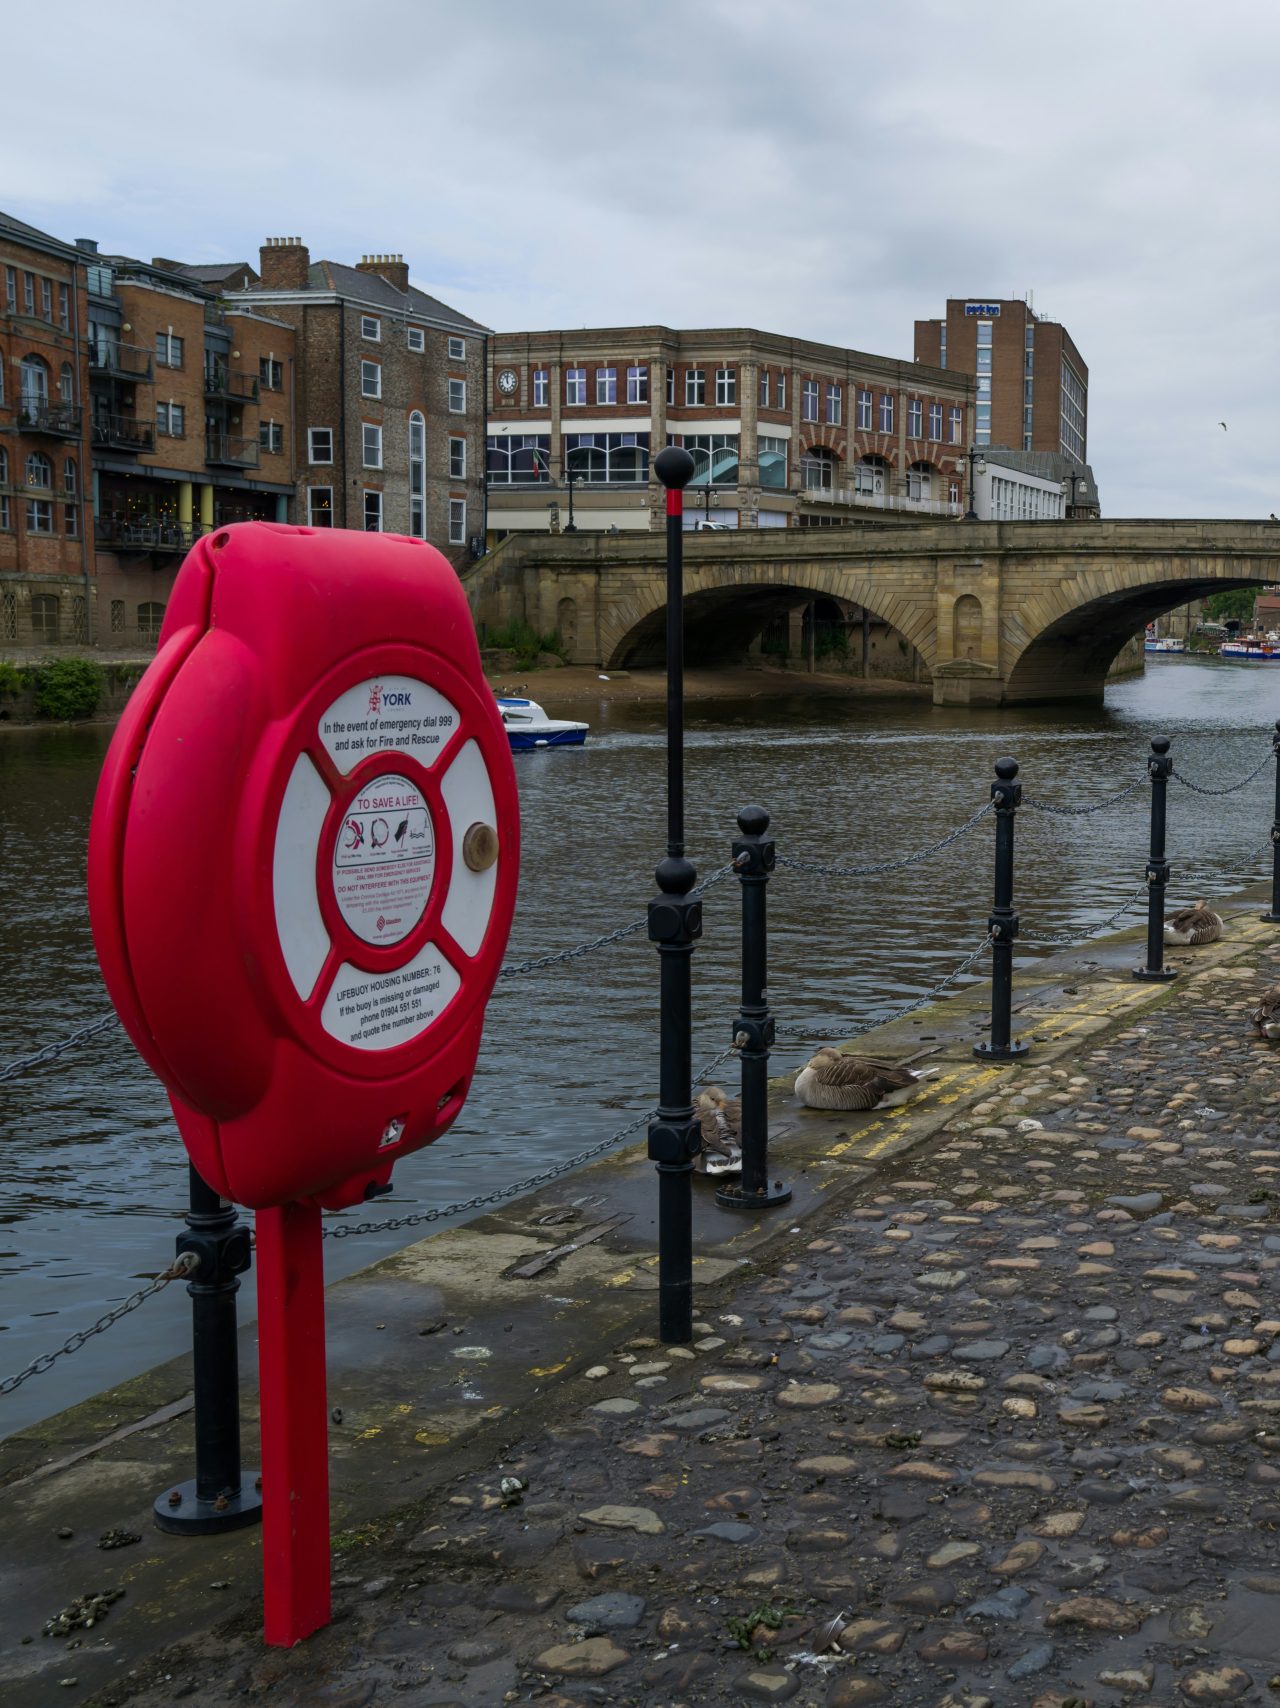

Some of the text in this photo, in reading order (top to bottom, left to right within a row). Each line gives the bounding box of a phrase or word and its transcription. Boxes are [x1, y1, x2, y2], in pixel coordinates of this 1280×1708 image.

[382, 693, 412, 706] YORK
[324, 716, 452, 734] In the event of emergency dial 999
[335, 734, 440, 751] and ask for Fire and Rescue
[358, 795, 419, 809] TO SAVE A LIFE!
[359, 882, 388, 890] INTERFERE
[336, 965, 440, 1001] LIFEBUOY HOUSING NUMBER: 76
[340, 1007, 345, 1017] If
[346, 1006, 355, 1015] the
[356, 1001, 372, 1011] buoy
[373, 999, 378, 1007] is
[380, 992, 404, 1005] missing
[413, 980, 440, 996] damaged
[360, 998, 422, 1026] phone 01904 551 551
[350, 1010, 434, 1042] and quote the number above
